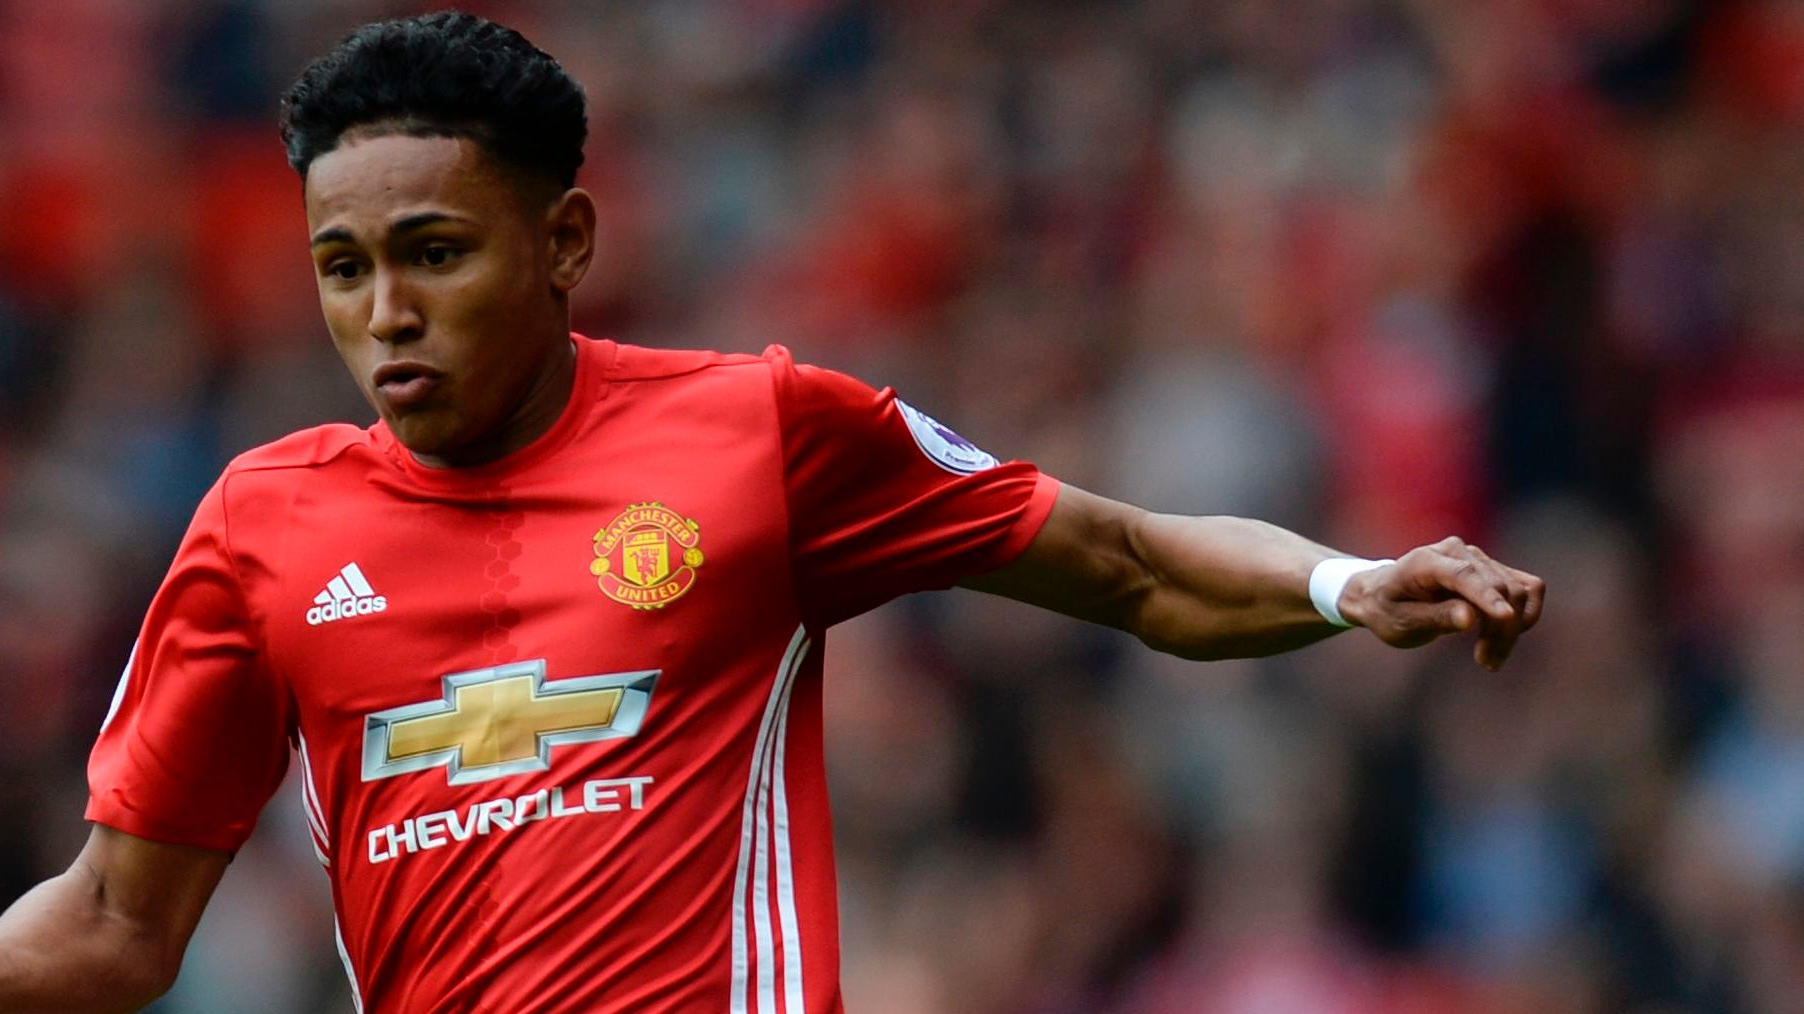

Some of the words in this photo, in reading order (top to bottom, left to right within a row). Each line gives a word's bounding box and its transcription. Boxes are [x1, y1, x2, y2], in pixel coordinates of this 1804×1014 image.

[602, 509, 691, 549] MANCHESTER
[306, 593, 387, 625] adidas
[615, 581, 680, 602] UNITED
[367, 776, 654, 864] CHEVROLET
